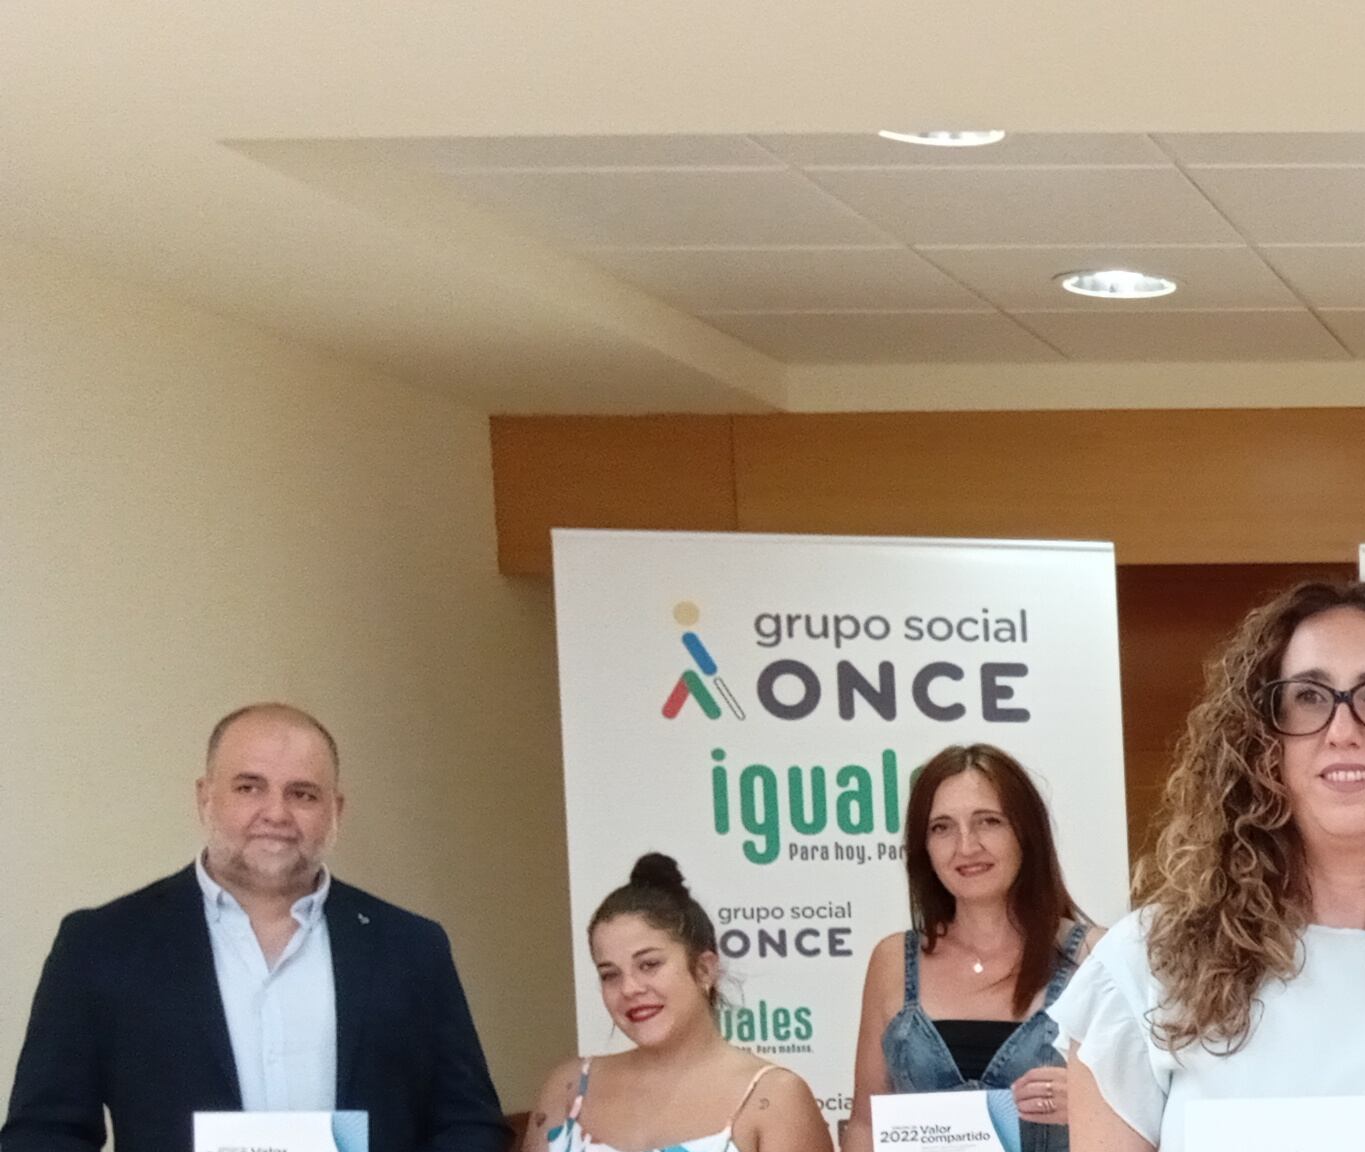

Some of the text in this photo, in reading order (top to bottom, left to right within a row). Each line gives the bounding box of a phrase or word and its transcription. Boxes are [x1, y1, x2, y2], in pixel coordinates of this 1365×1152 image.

[754, 608, 1028, 648] grupo social
[757, 659, 1031, 723] ONCE
[711, 748, 924, 865] igual
[789, 842, 907, 865] Para hoy. Par
[718, 902, 852, 924] grupo social
[719, 927, 853, 958] ONCE
[880, 1124, 951, 1143] 2022 Valor
[921, 1131, 990, 1144] compartido
